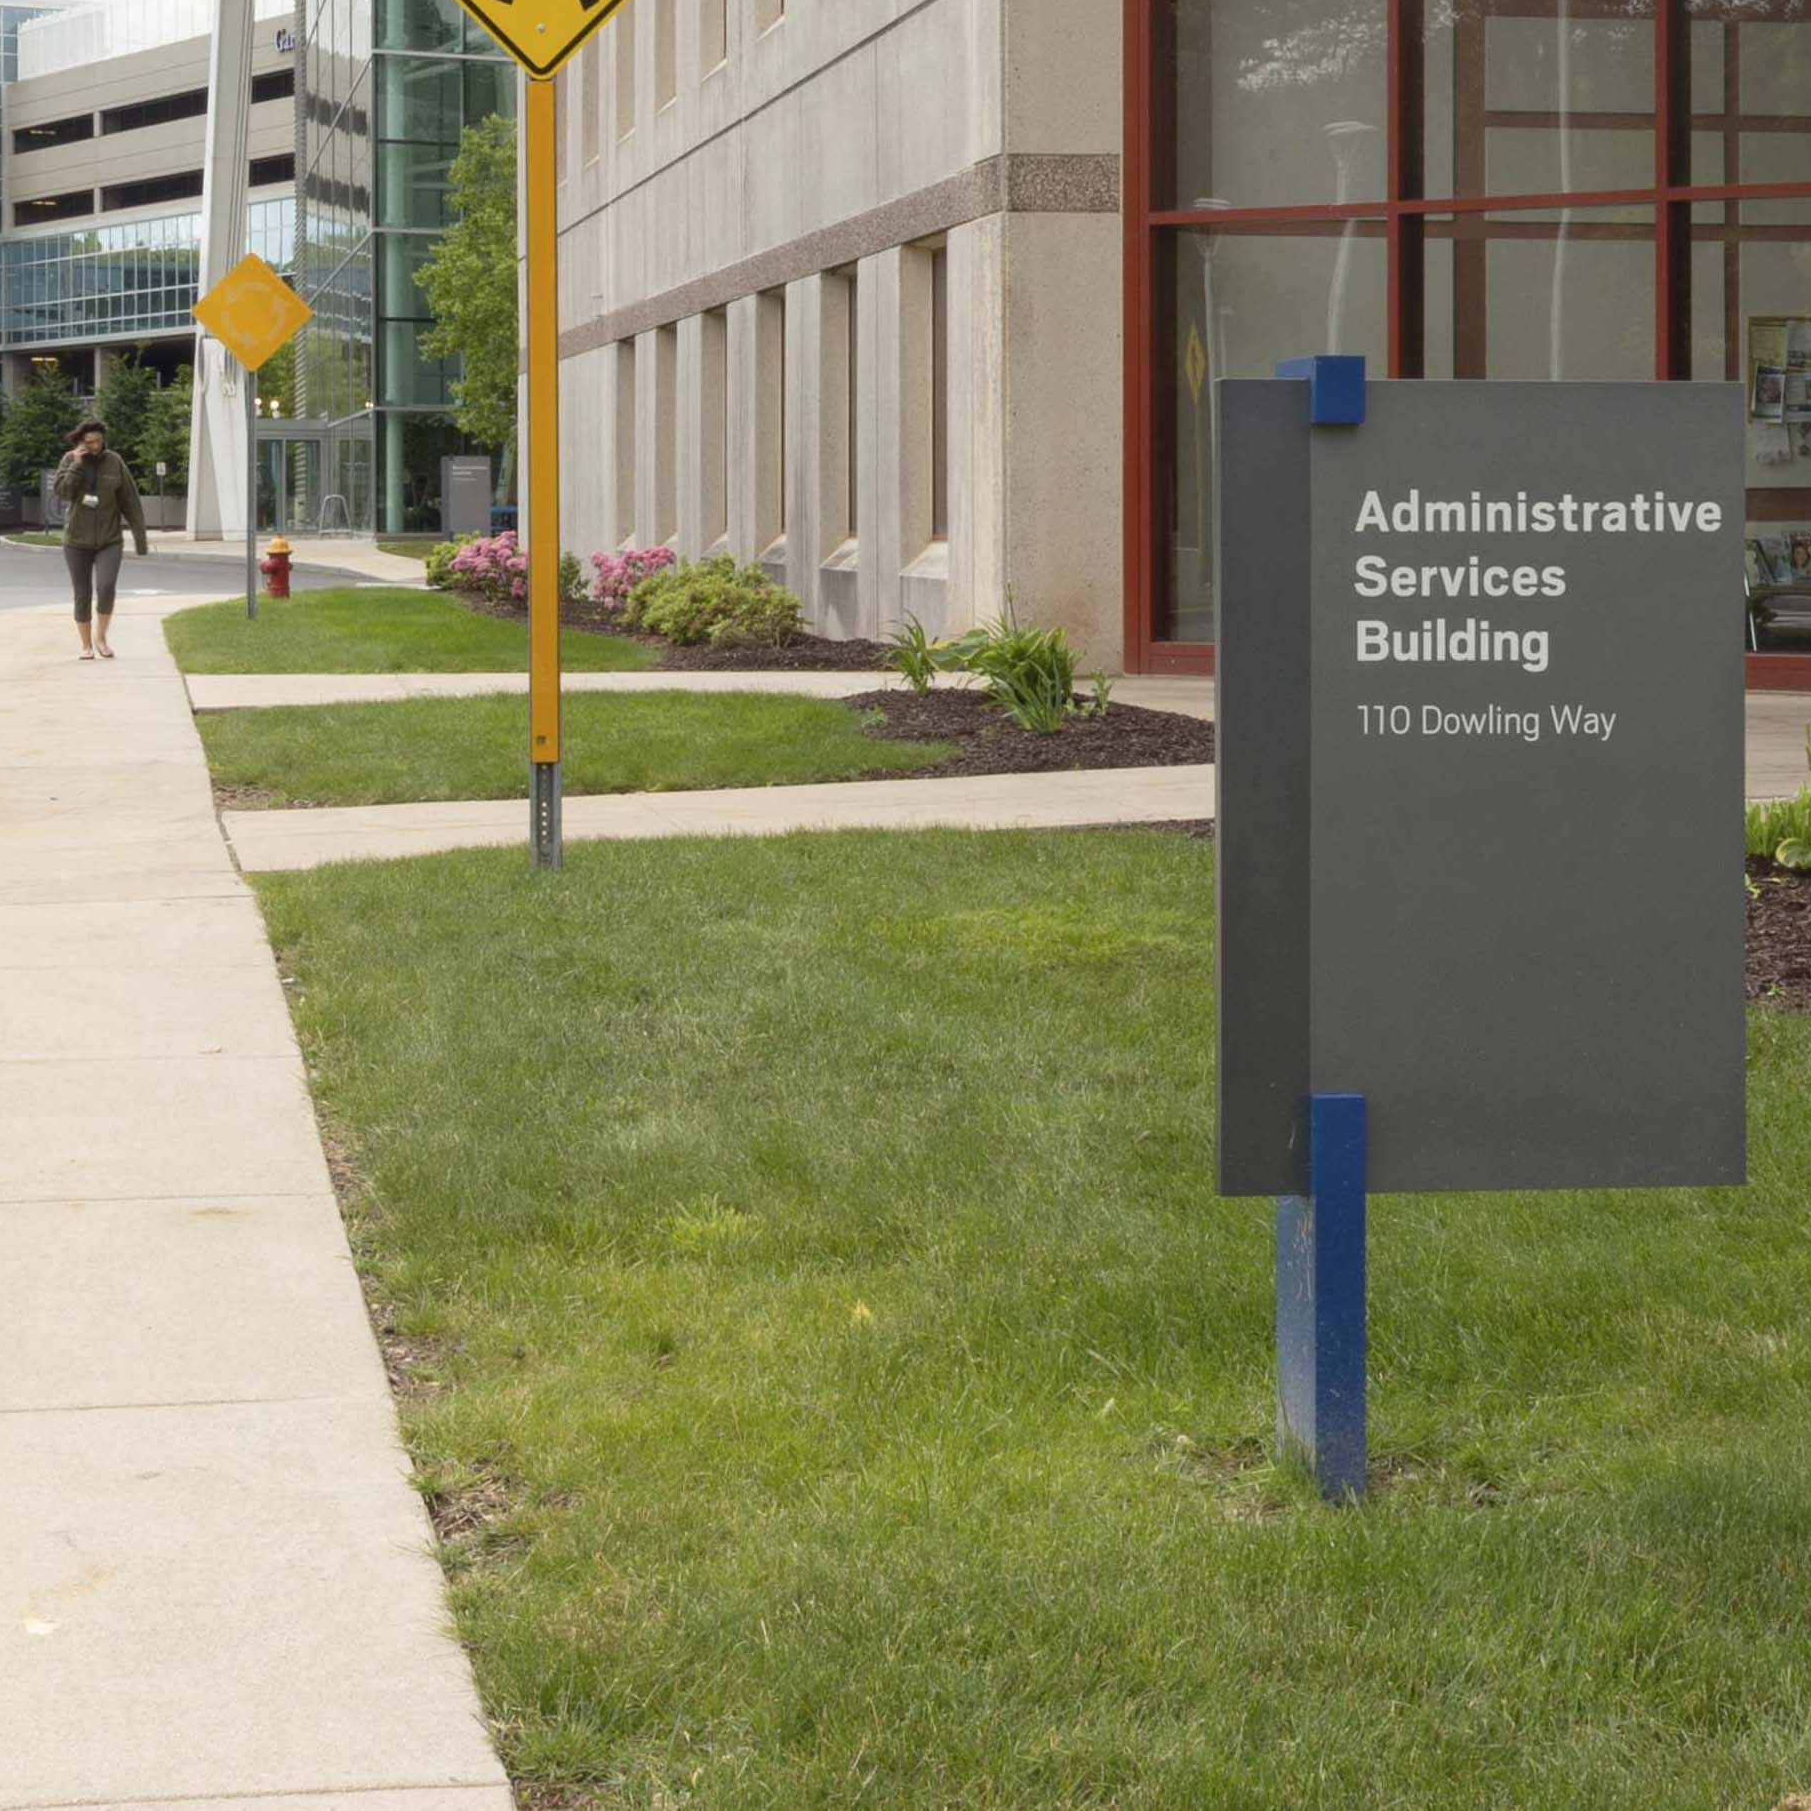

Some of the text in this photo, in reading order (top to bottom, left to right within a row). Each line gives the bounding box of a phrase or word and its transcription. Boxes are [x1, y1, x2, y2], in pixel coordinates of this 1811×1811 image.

[1354, 488, 1723, 533] Administrative
[1353, 554, 1567, 598] Services
[1356, 617, 1549, 673] Building
[1357, 703, 1617, 742] 110 Dowling Way
